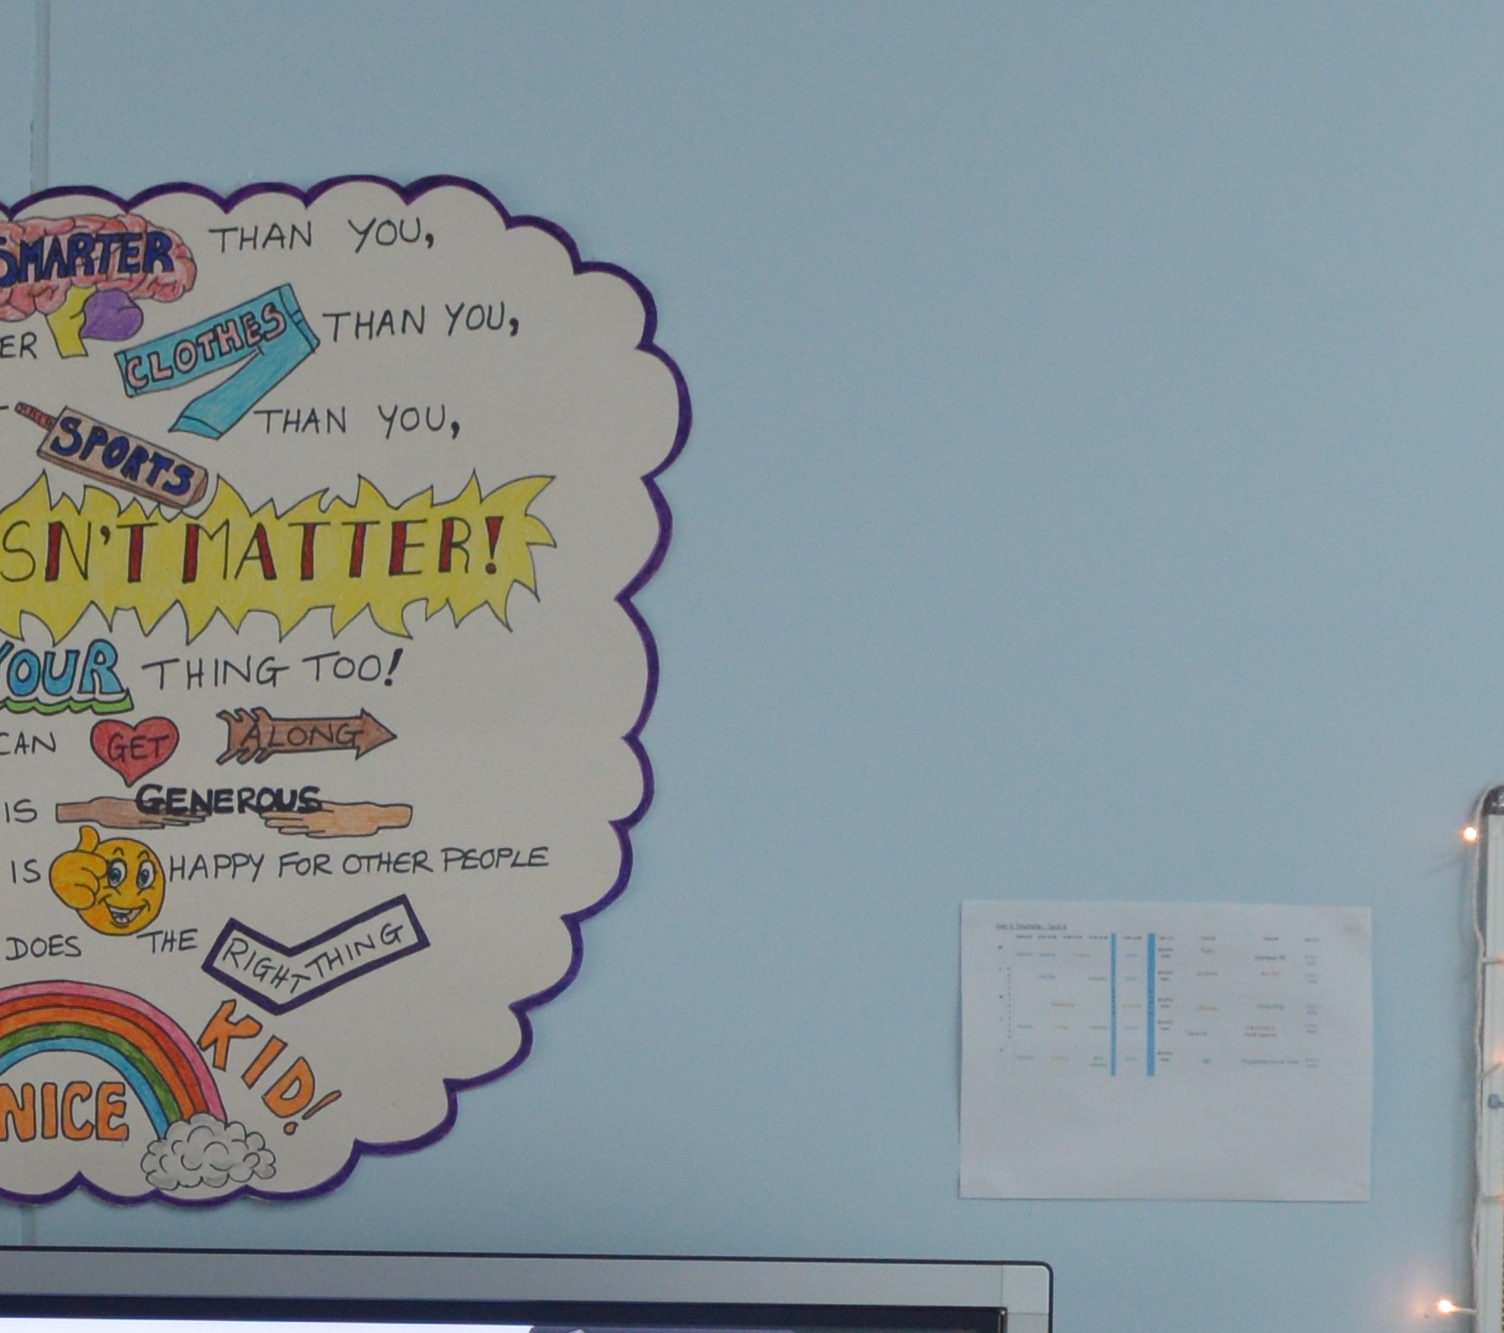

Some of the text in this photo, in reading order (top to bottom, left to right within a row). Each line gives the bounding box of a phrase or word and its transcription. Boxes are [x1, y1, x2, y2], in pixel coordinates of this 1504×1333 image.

[209, 218, 315, 257] THAN
[346, 213, 436, 252] YOU,
[124, 299, 290, 391] CLOTHES
[322, 306, 427, 346] THAN
[444, 297, 522, 344] YOU,
[49, 413, 196, 499] SPORTS
[252, 405, 348, 439] THAN
[377, 404, 462, 442] YOU,
[180, 512, 505, 585] MATTER!
[142, 650, 291, 691] THING
[301, 645, 405, 688] TOO!
[106, 730, 169, 763] GET
[238, 717, 367, 753] ALONG
[9, 860, 43, 887] IS
[168, 846, 266, 885] HAPPY
[277, 848, 334, 881] FOR
[340, 846, 434, 879] OTHER
[440, 843, 549, 873] PEOPLE
[194, 1000, 343, 1134] KID!
